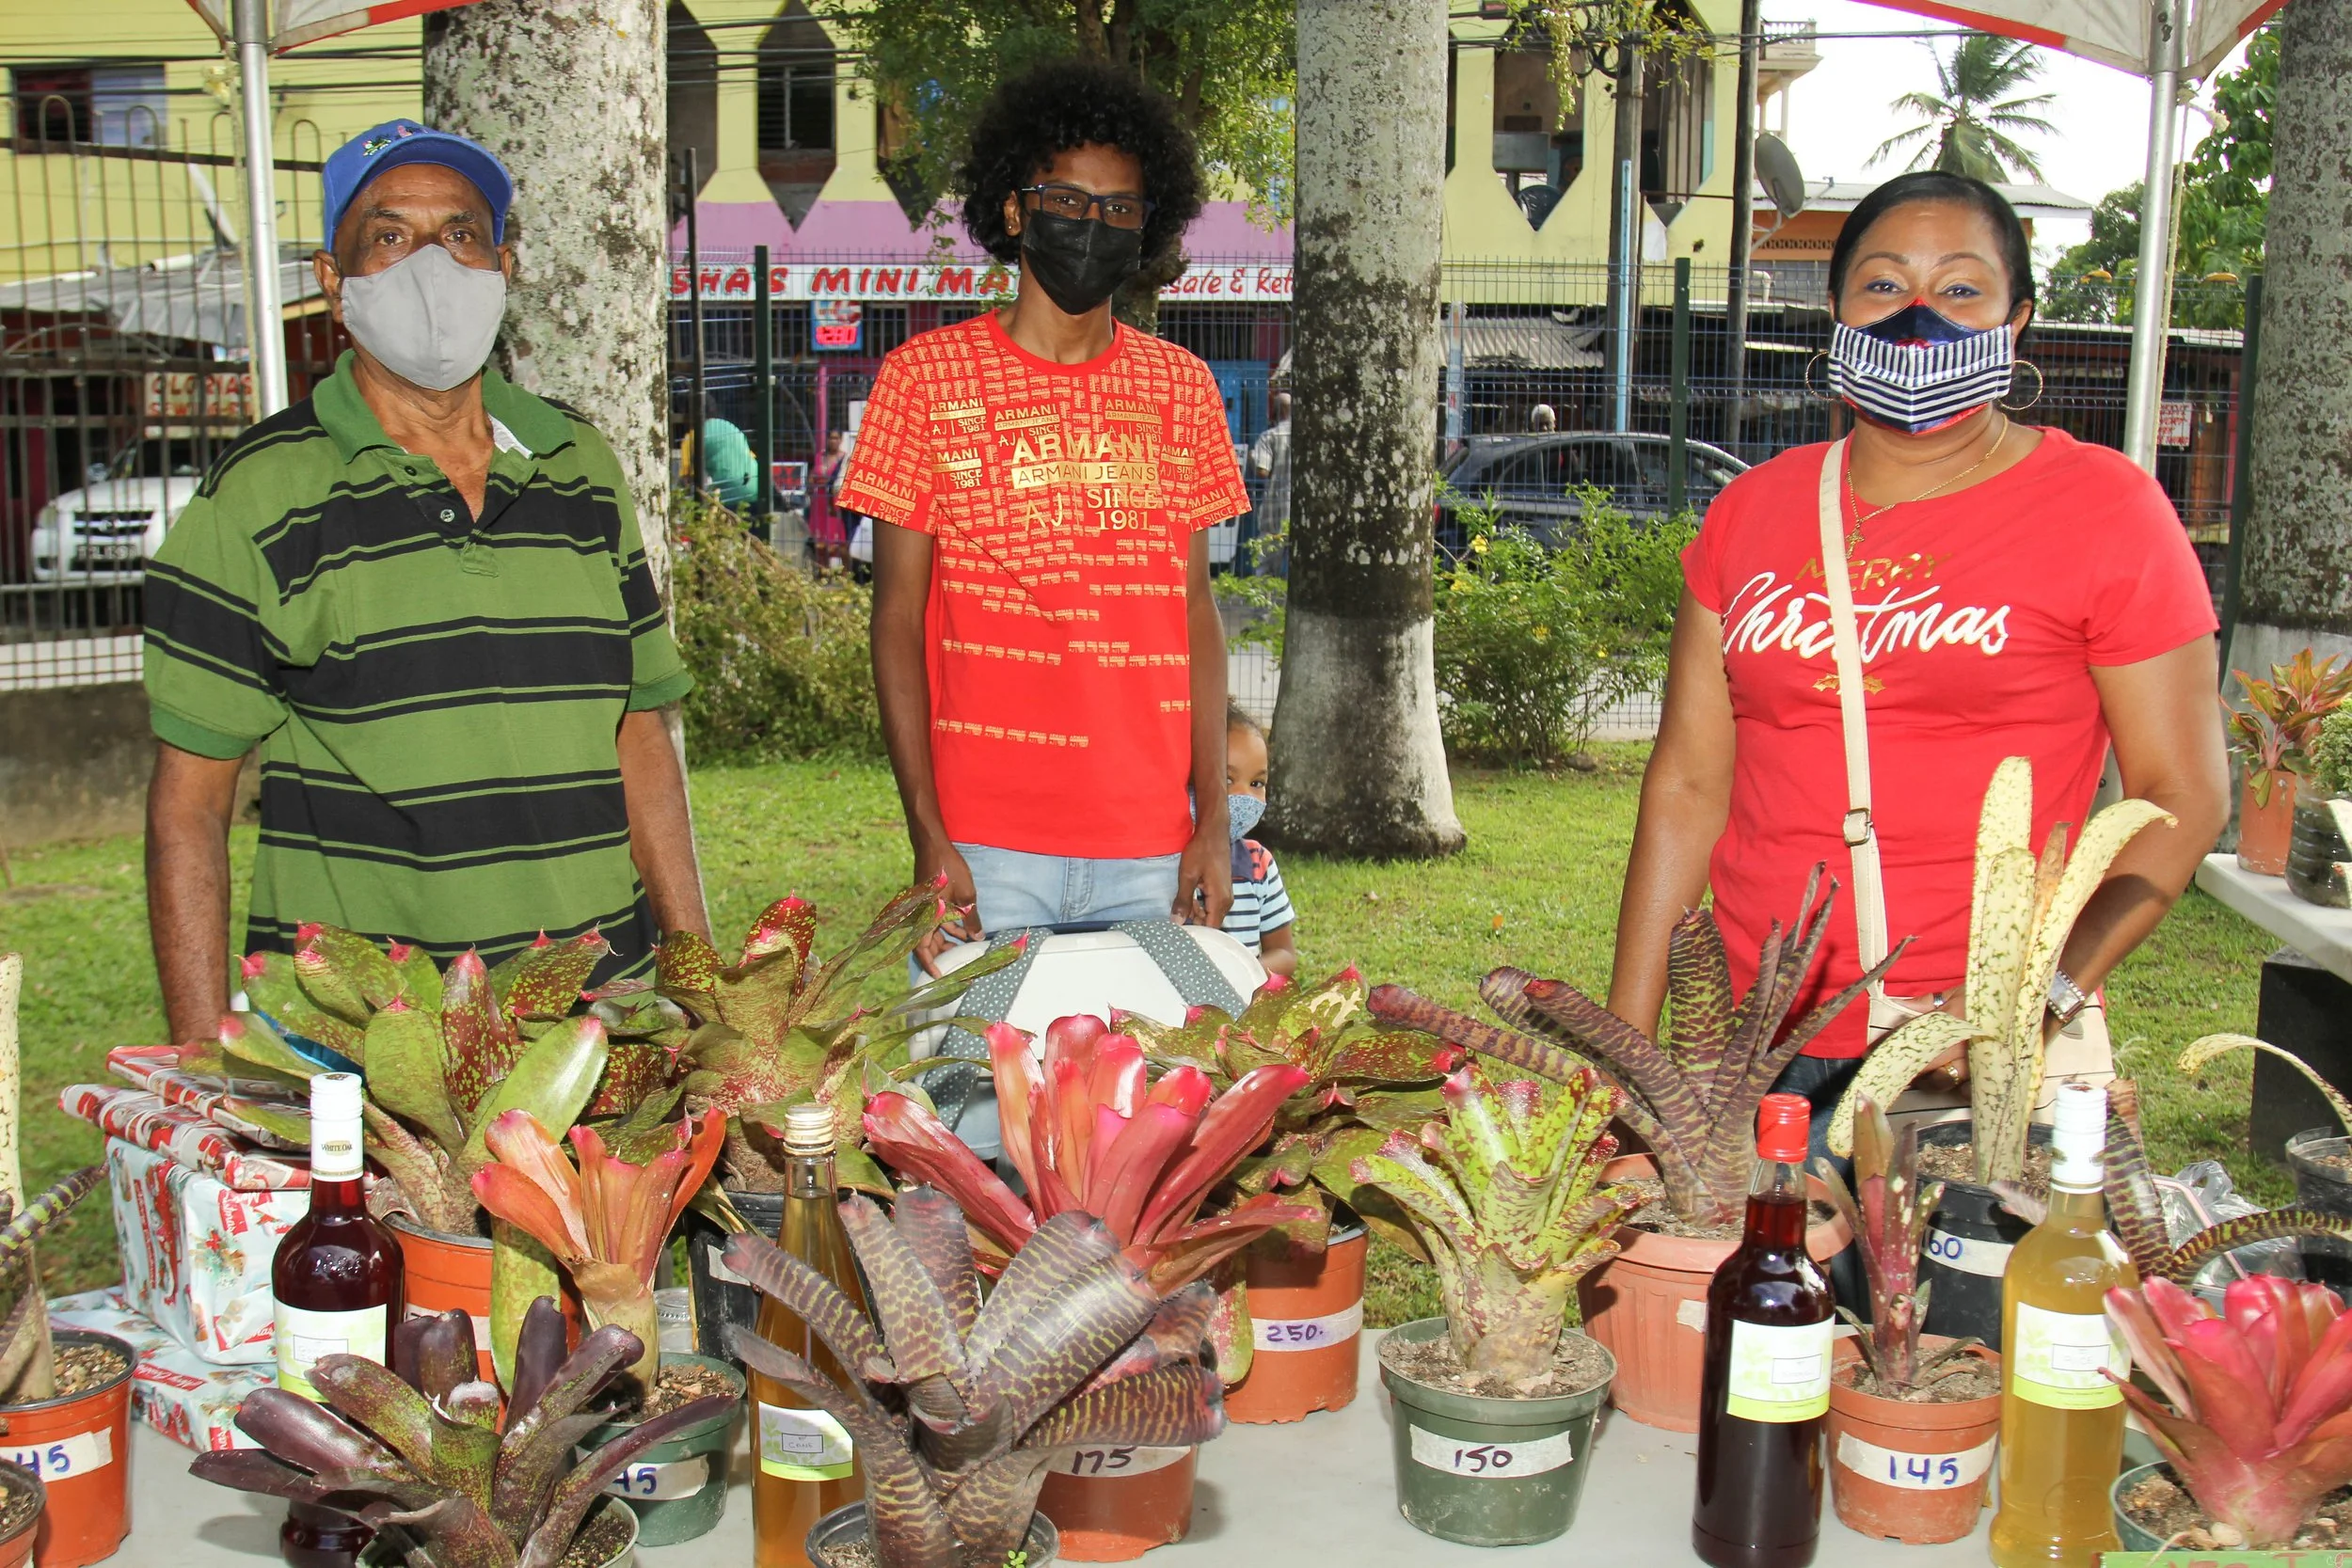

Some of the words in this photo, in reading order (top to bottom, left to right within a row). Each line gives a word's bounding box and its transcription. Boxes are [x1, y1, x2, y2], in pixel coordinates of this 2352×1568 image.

[670, 267, 788, 294] SHAS
[811, 267, 919, 293] MINI
[1229, 267, 1246, 293] &
[929, 397, 984, 412] ARMANI
[994, 404, 1057, 421] ARMANI
[1105, 398, 1159, 415] ARMANI
[958, 416, 987, 426] SINCE
[962, 423, 986, 434] 1981
[1028, 424, 1061, 436] SINCE
[1136, 422, 1164, 435] SINCE
[1011, 433, 1154, 464] ARMANI
[853, 468, 916, 501] ARMANI
[949, 468, 983, 481] SINCE
[954, 478, 981, 489] 1981
[1018, 466, 1088, 485] ARMANI
[1094, 465, 1156, 482] JEANS
[1087, 487, 1157, 509] SINCE
[877, 501, 912, 521] SINCE
[1095, 510, 1150, 531] 1981
[1204, 505, 1235, 524] SINCE
[1722, 571, 2010, 664] Chritmas
[322, 1144, 342, 1152] WHITE
[1071, 1446, 1137, 1475] 175
[1454, 1445, 1513, 1473] 150
[1889, 1455, 1960, 1485] 145
